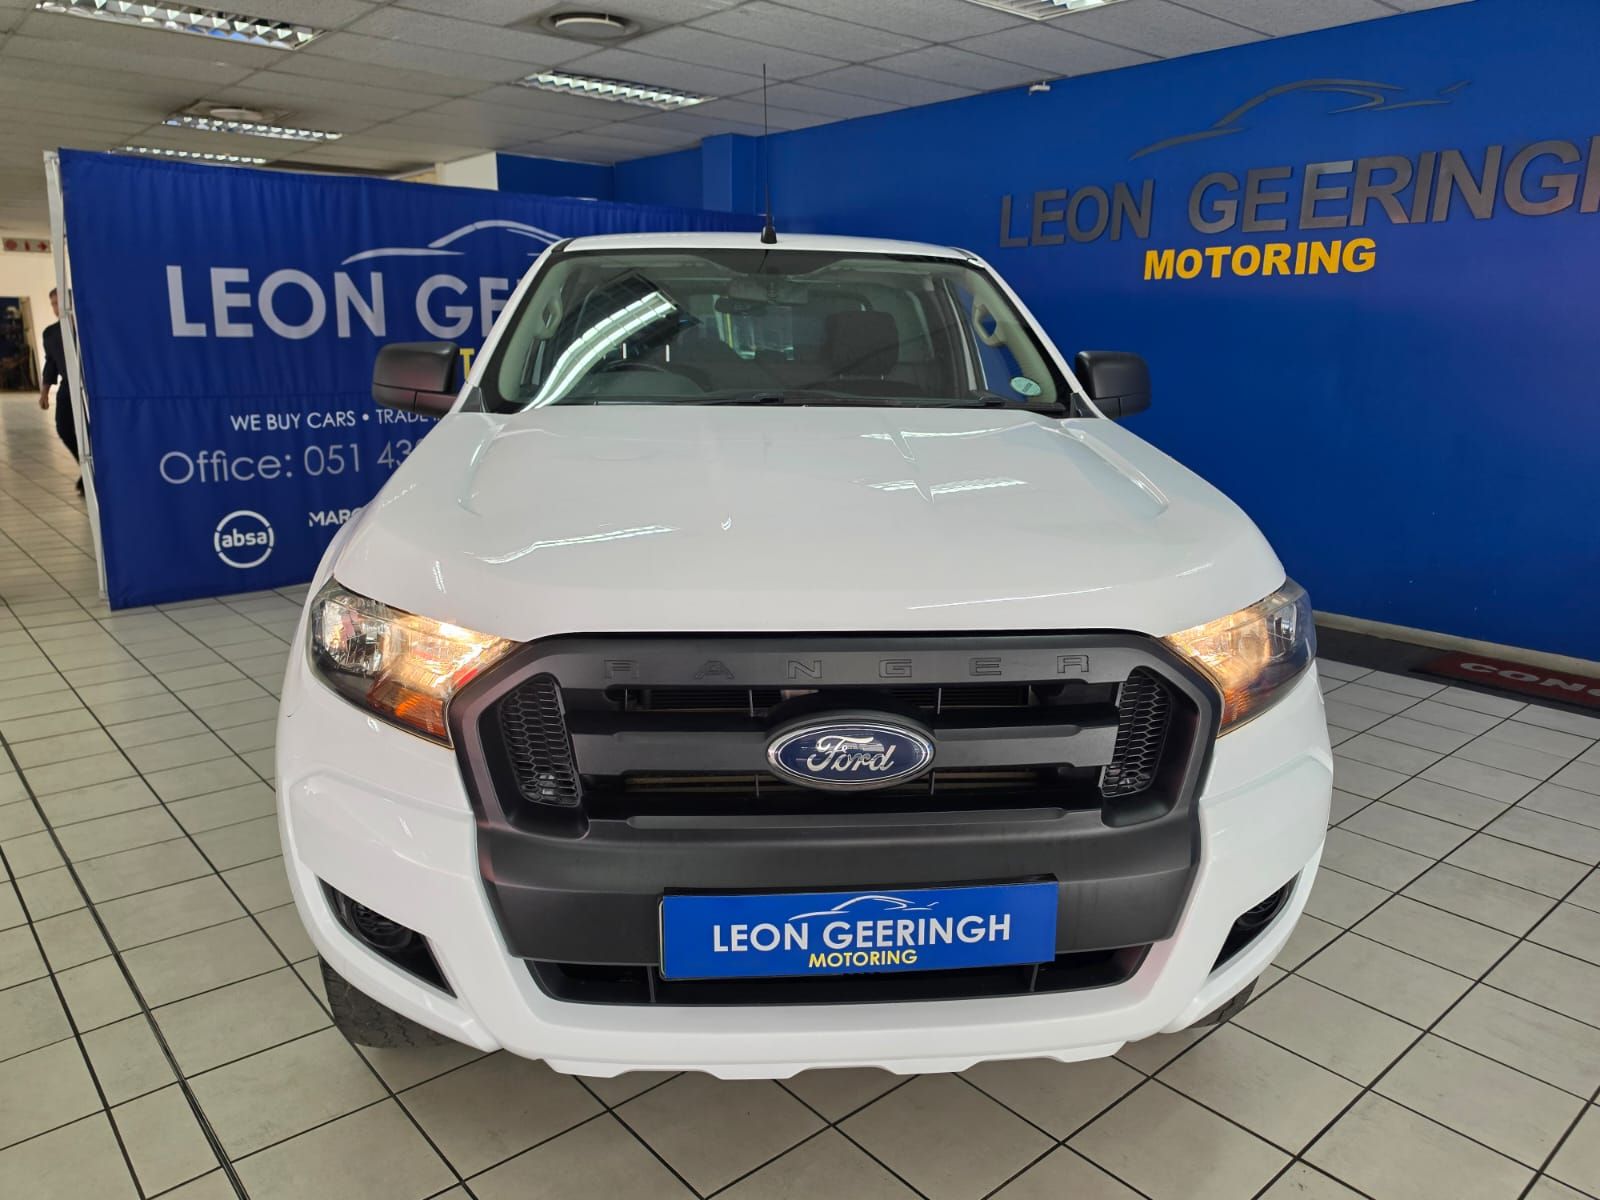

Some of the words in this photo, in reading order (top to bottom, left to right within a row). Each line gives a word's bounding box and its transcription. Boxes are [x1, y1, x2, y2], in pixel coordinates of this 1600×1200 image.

[999, 178, 1154, 248] LEON
[1143, 237, 1376, 281] MOTORING
[166, 265, 387, 340] LEON
[230, 414, 262, 432] WE
[266, 413, 301, 431] BUY
[306, 410, 357, 429] CARS
[159, 449, 293, 485] Office:
[304, 443, 360, 476] 051
[377, 438, 424, 469] 43
[221, 527, 268, 548] absa
[602, 654, 1090, 680] RANGER
[1460, 661, 1600, 697] CON
[806, 735, 897, 772] Ford
[712, 922, 809, 952] LEON
[822, 913, 1012, 950] GEERINGH
[808, 949, 918, 968] MOTORING
